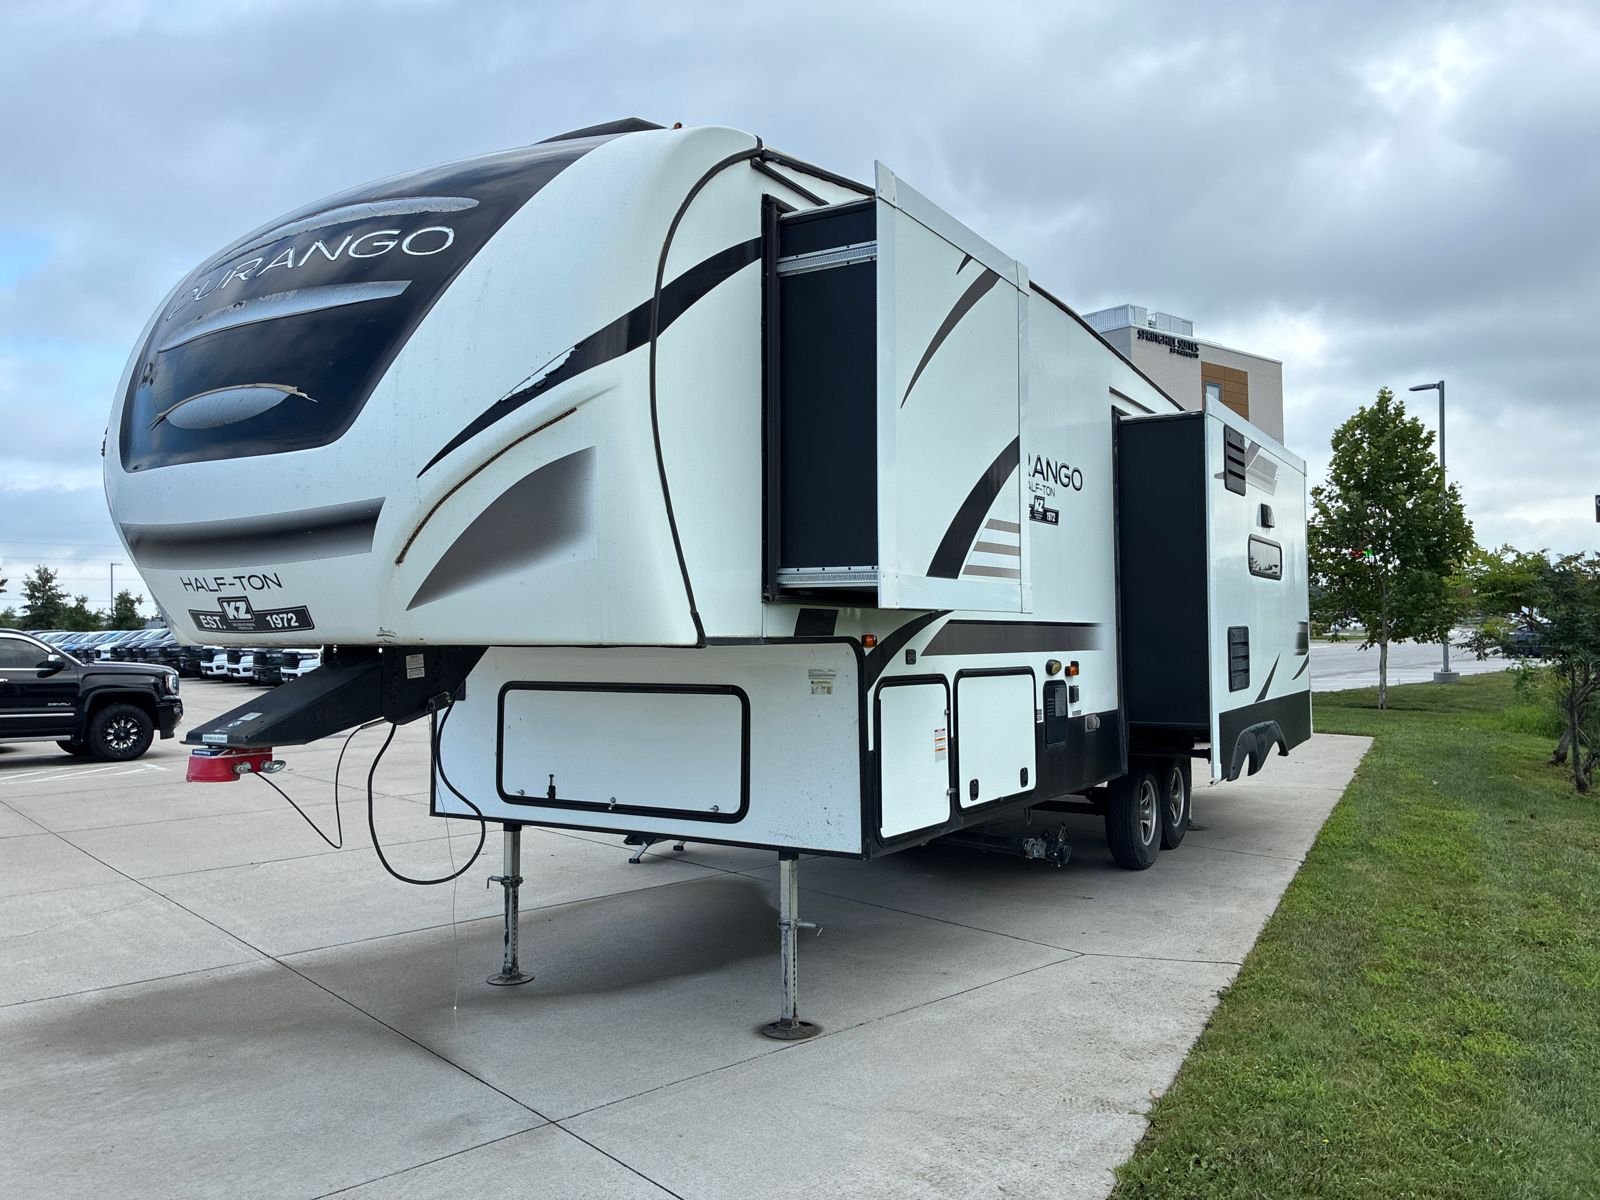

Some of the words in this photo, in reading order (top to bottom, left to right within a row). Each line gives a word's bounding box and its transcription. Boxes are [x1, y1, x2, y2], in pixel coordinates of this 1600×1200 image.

[166, 226, 455, 322] DURANGO
[180, 572, 283, 592] HALF-TON
[222, 601, 252, 620] KZ
[200, 616, 226, 629] EST.
[266, 613, 299, 628] 1972
